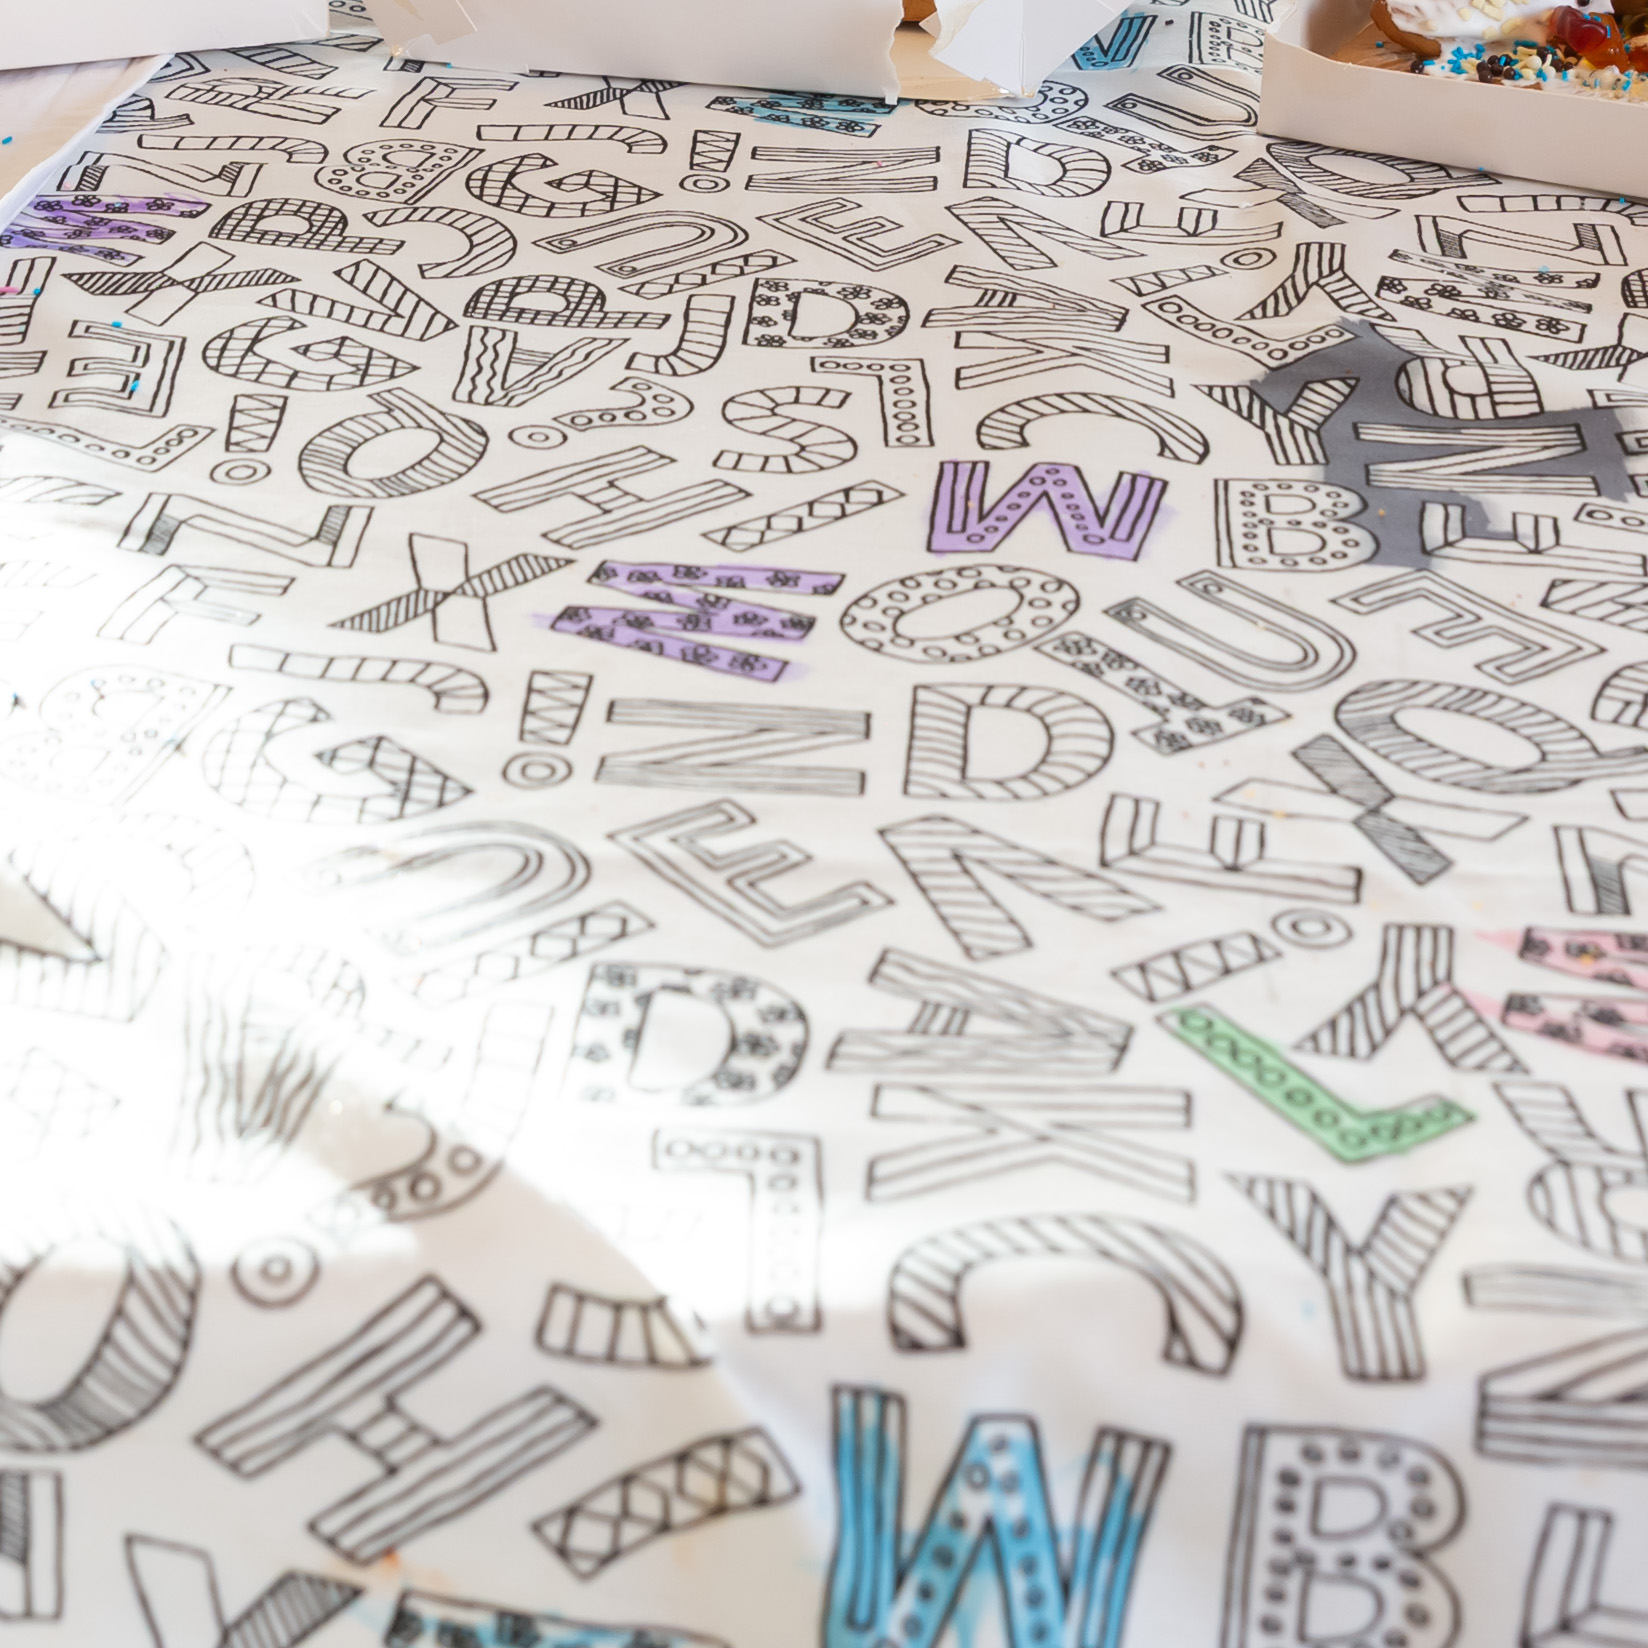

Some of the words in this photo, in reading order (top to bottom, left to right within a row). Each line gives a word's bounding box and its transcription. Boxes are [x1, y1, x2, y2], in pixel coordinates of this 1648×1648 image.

[380, 77, 518, 130] F
[962, 128, 1110, 198] D
[757, 197, 961, 272] E
[626, 294, 735, 377] J
[742, 278, 910, 349] D
[712, 387, 858, 474] S
[1194, 377, 1358, 465] Y
[472, 445, 753, 549] H
[1214, 478, 1381, 572] B
[329, 533, 575, 650] X
[841, 565, 1080, 663] O
[904, 684, 1115, 800] D
[607, 799, 896, 948] E
[1224, 1175, 1476, 1382] Y
[192, 1274, 600, 1555] H
